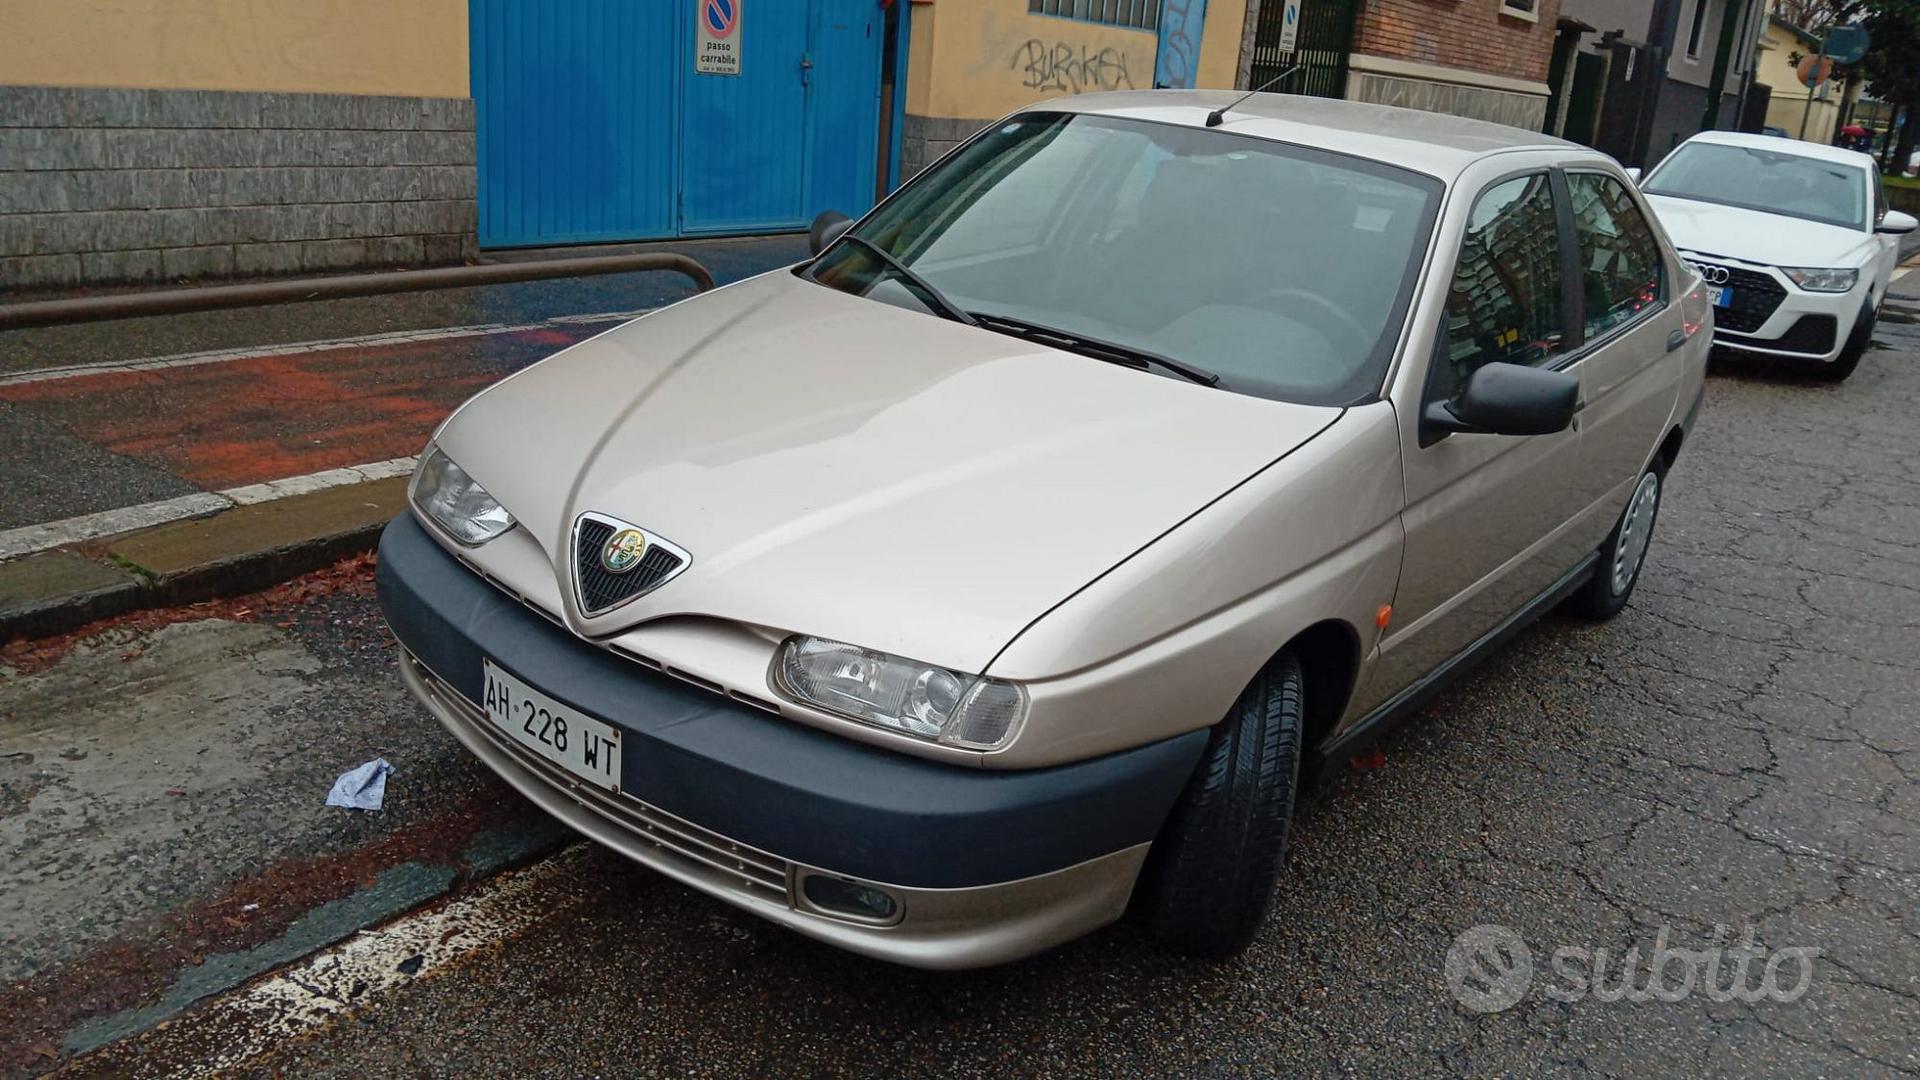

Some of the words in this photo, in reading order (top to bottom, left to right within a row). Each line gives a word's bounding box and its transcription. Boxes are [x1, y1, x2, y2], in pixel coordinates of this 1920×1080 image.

[706, 42, 731, 51] passo
[701, 54, 736, 64] carrabile
[584, 730, 617, 776] WT
